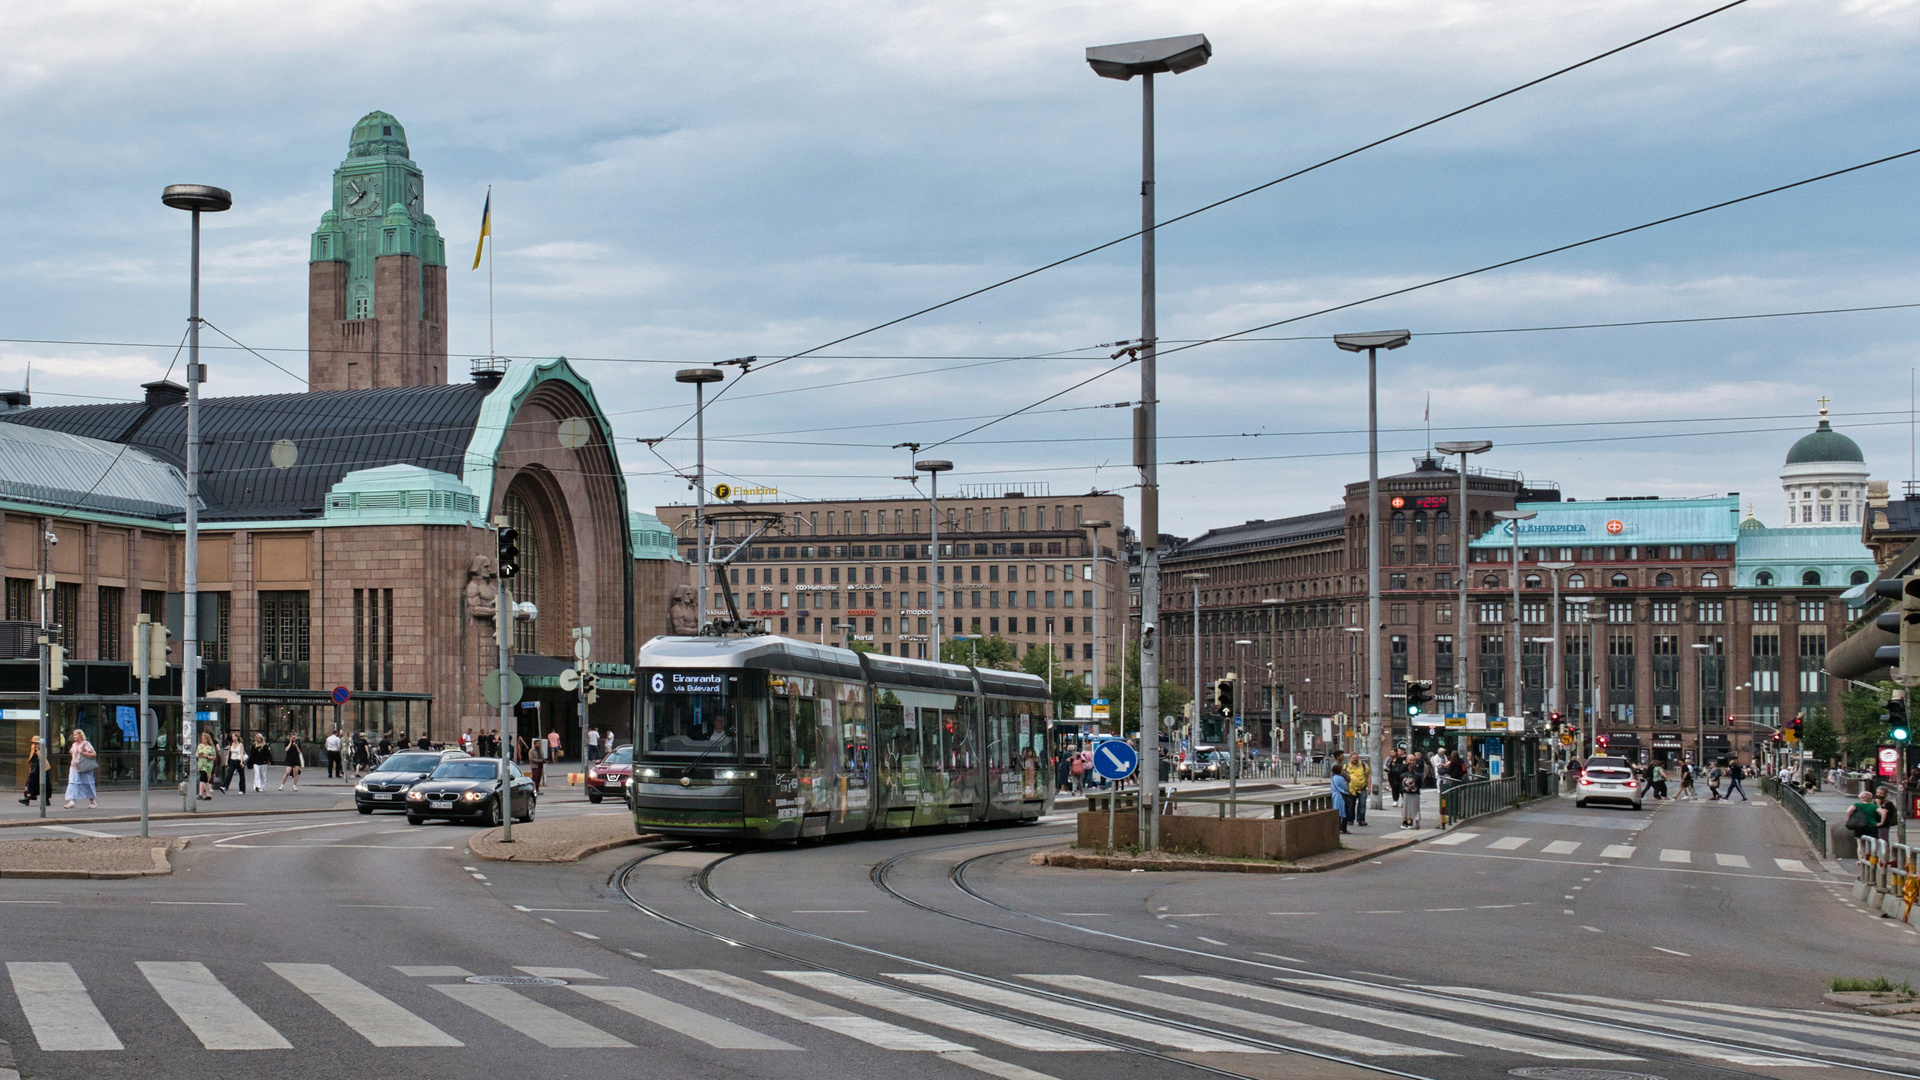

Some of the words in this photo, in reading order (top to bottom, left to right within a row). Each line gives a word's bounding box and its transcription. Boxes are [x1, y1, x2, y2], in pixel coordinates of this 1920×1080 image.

[733, 486, 778, 496] Finnkino
[1521, 523, 1586, 533] LÄHITAPIOLA
[651, 673, 665, 692] 6
[673, 674, 721, 683] Eiranranta
[674, 684, 685, 692] via
[687, 684, 720, 692] Bulevardi
